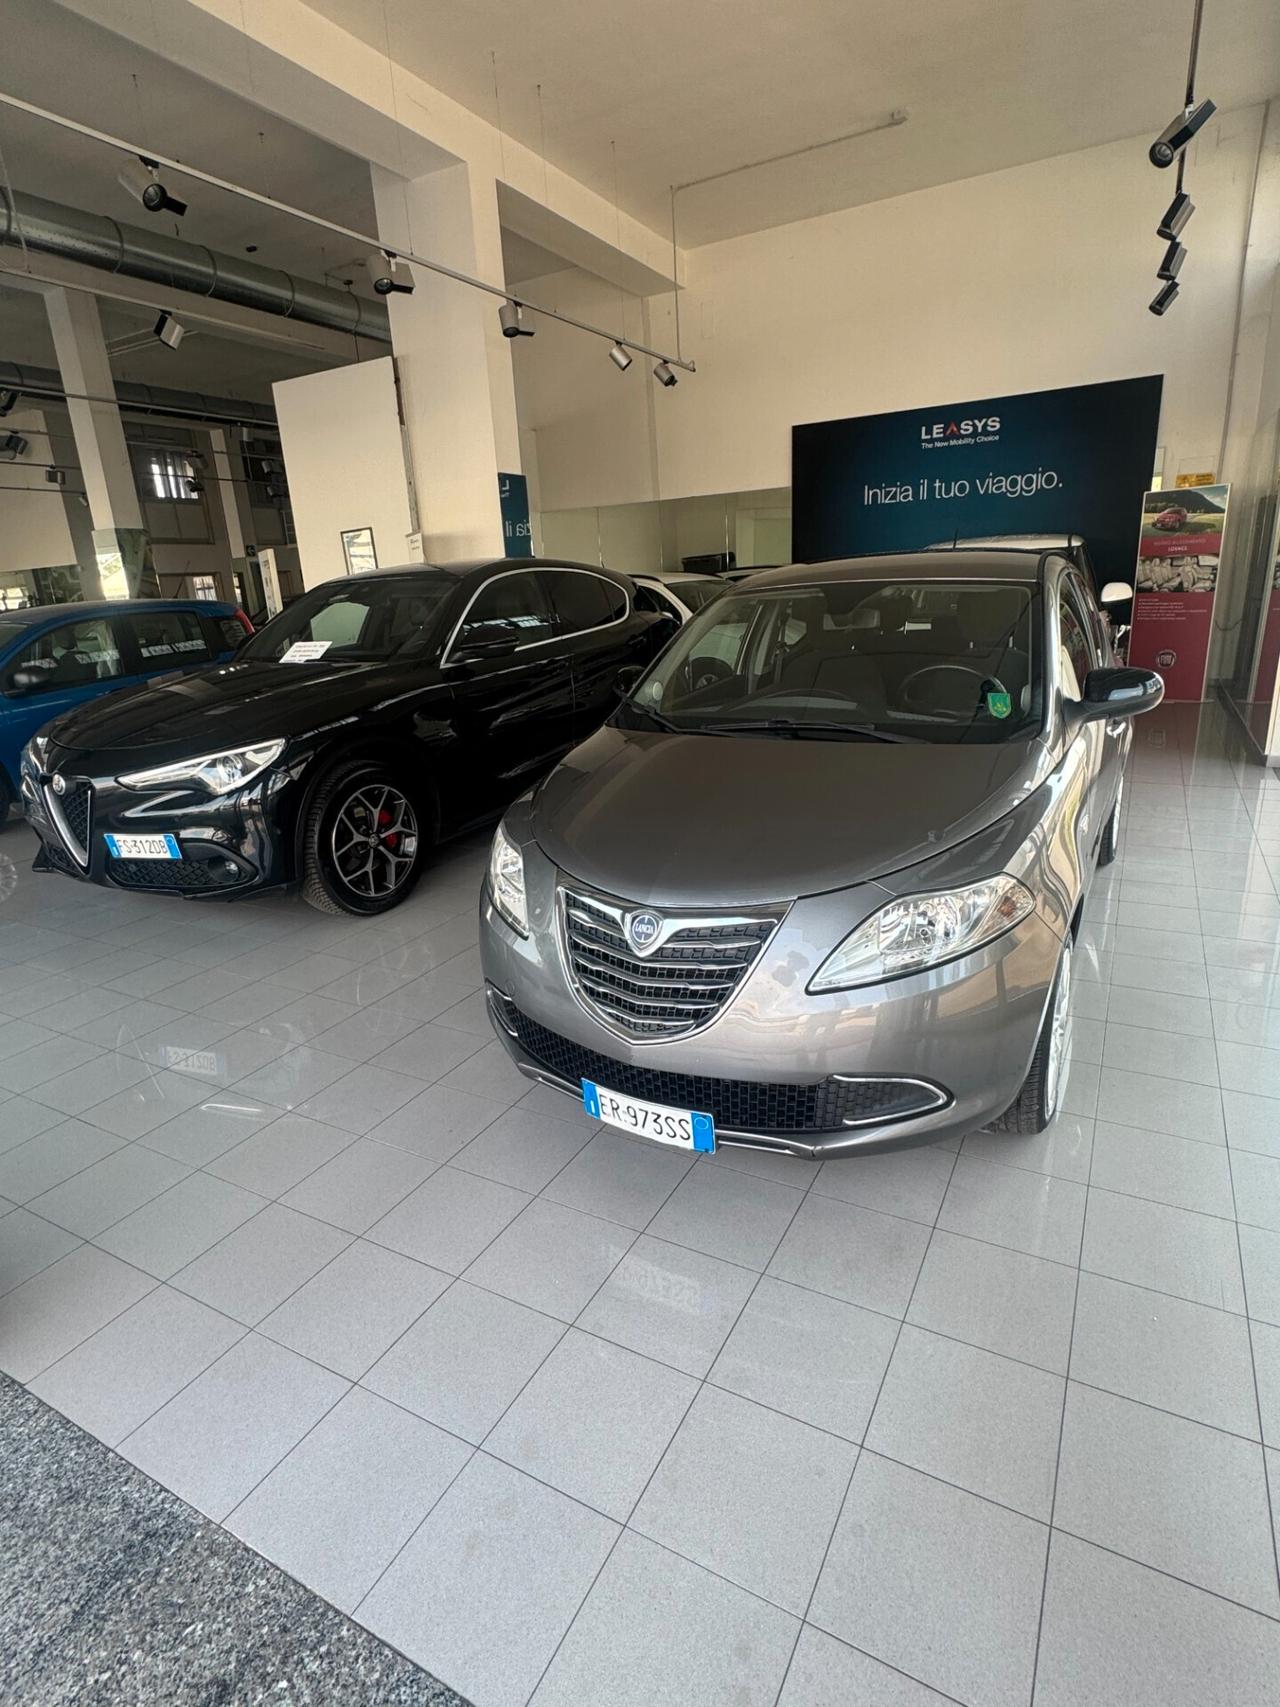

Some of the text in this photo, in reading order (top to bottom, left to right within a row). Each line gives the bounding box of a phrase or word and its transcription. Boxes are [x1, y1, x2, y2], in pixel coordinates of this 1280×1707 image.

[921, 416, 1001, 440] LEASYS
[934, 440, 948, 448] New
[949, 437, 975, 446] Mobility
[976, 435, 1000, 443] Choice
[864, 467, 1063, 505] Inizia il tuo viaggio.
